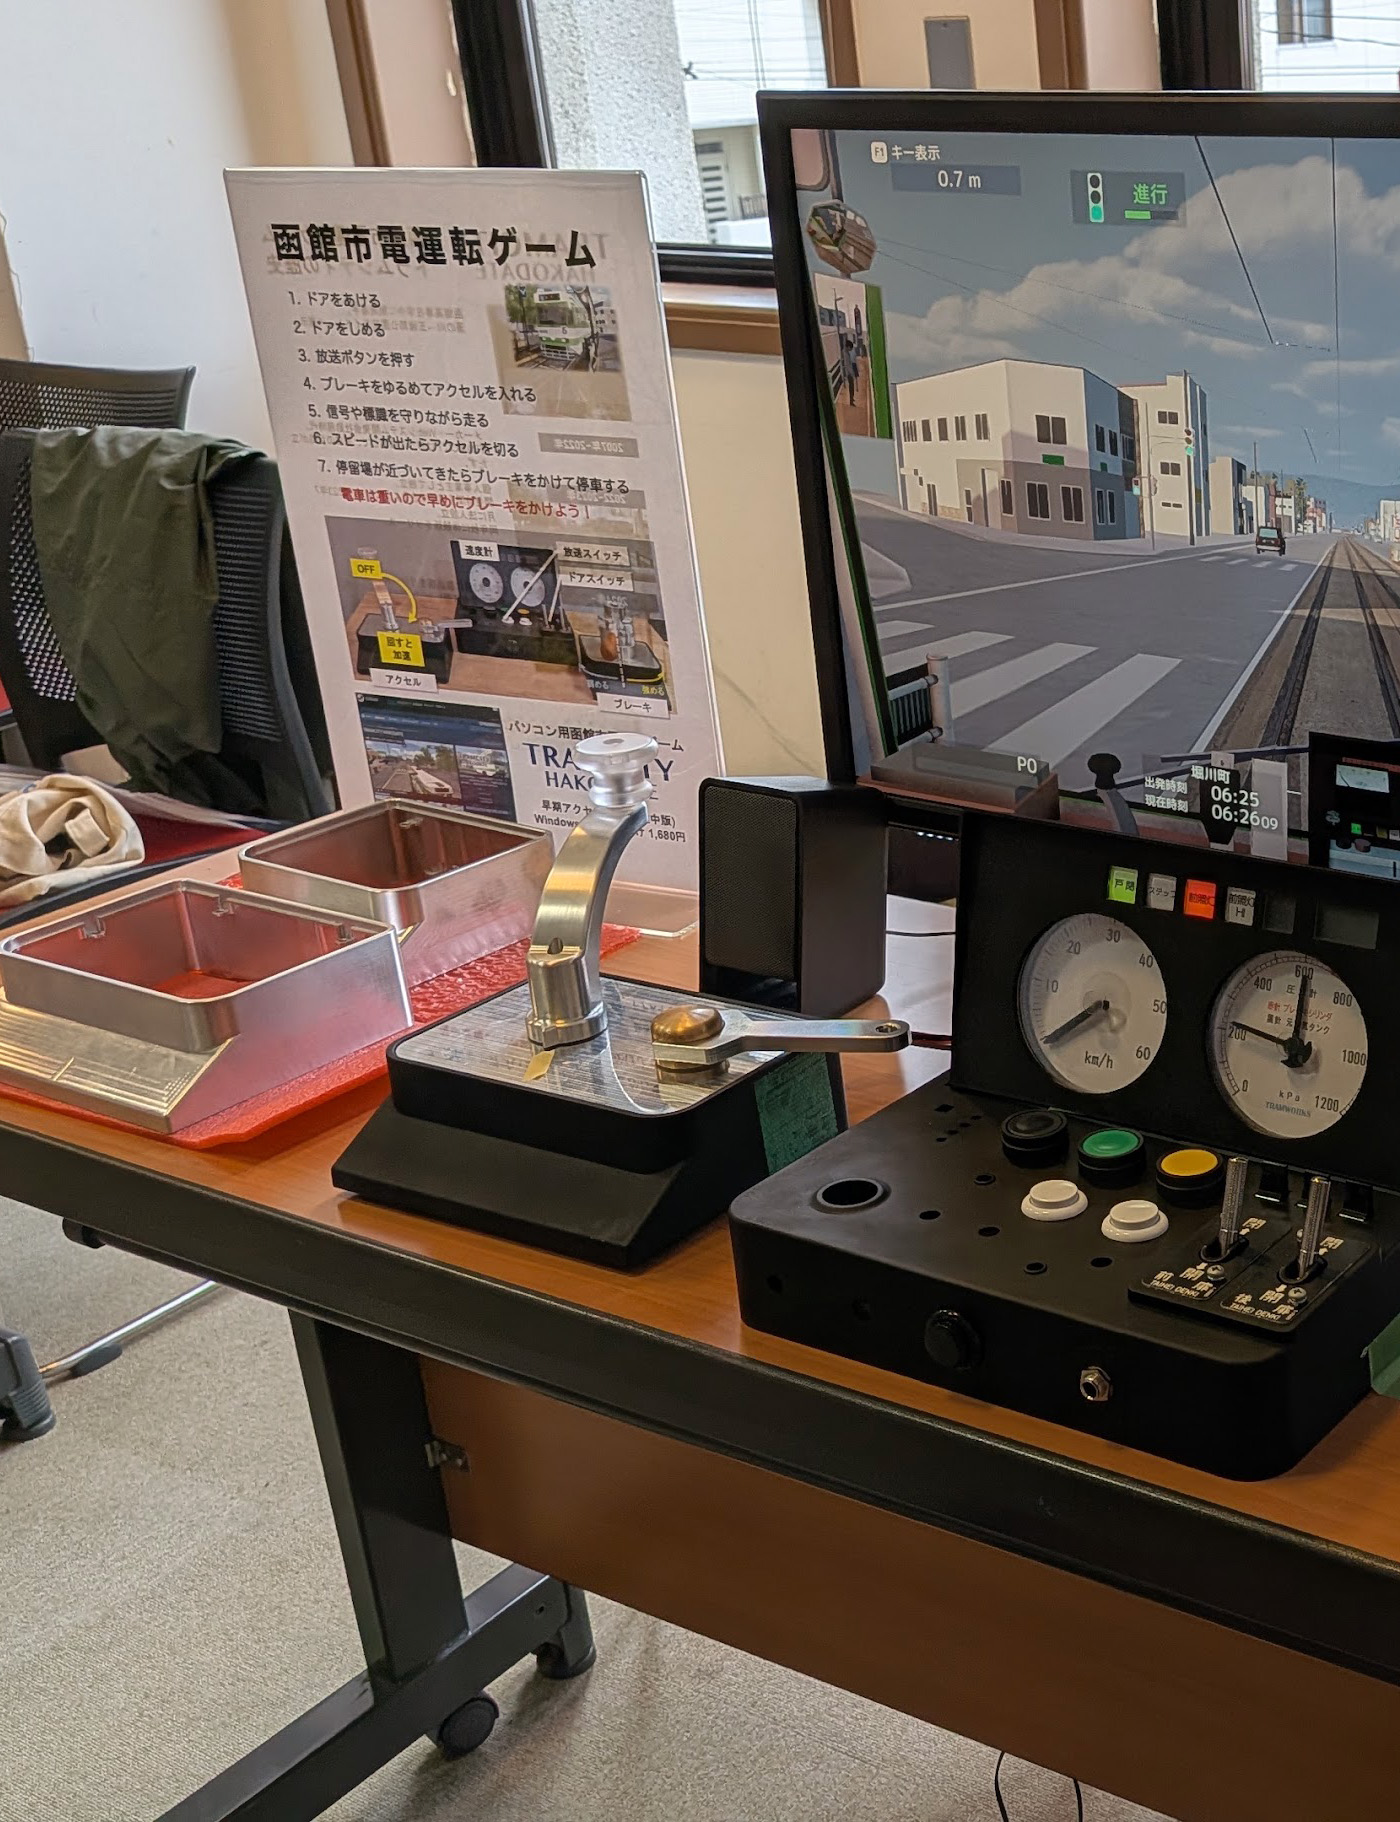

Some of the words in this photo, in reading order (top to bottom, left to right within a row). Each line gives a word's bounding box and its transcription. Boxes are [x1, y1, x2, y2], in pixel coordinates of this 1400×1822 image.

[891, 145, 940, 161] キー表示
[938, 170, 964, 189] 0.7
[967, 174, 982, 189] m
[1133, 184, 1168, 205] 進行
[271, 223, 597, 268] 函館市電運転ゲーム
[288, 291, 301, 306] 1.
[308, 291, 381, 308] ドアをあける
[293, 320, 306, 335] 2.
[312, 321, 386, 337] ドアをしめる
[298, 349, 311, 362] 3.
[316, 350, 415, 367] 放送ボタンを押す
[303, 377, 316, 391] 4.
[320, 378, 537, 402] ブレーキをゆるめてアクセルを入れる
[308, 404, 321, 418] 5.
[326, 405, 490, 428] 信号や標識を守りながら走る
[313, 432, 326, 445] 6.
[332, 433, 519, 458] スピードが出たらアクセルを切る
[318, 460, 331, 473] 7.
[336, 460, 630, 494] 停留場が近づいてきたらブレーキをかけて停車する
[563, 547, 621, 561] 放送スイッチ
[357, 564, 375, 575] OFF
[569, 572, 625, 586] ドアスイッチ
[385, 675, 422, 687] アクセル
[614, 699, 652, 713] ブレーキ
[1191, 764, 1230, 784] 堀川町
[1144, 776, 1188, 795] 出発時刻
[1211, 785, 1259, 808] 06:25
[1145, 794, 1188, 813] 現在時刻
[648, 828, 686, 843] 1,680円
[1105, 928, 1121, 943] 30
[1066, 940, 1081, 955] 20
[1138, 953, 1154, 968] 40
[1294, 965, 1314, 980] 600
[1046, 980, 1058, 993] 10
[1253, 976, 1273, 991] 400
[1152, 1000, 1167, 1014] 50
[1333, 991, 1353, 1007] 800
[1228, 1026, 1247, 1042] 200
[1084, 1051, 1114, 1068] km/h
[1135, 1046, 1151, 1060] 60
[1342, 1049, 1367, 1067] 1000
[1241, 1080, 1249, 1092] 0
[1315, 1095, 1340, 1113] 1200
